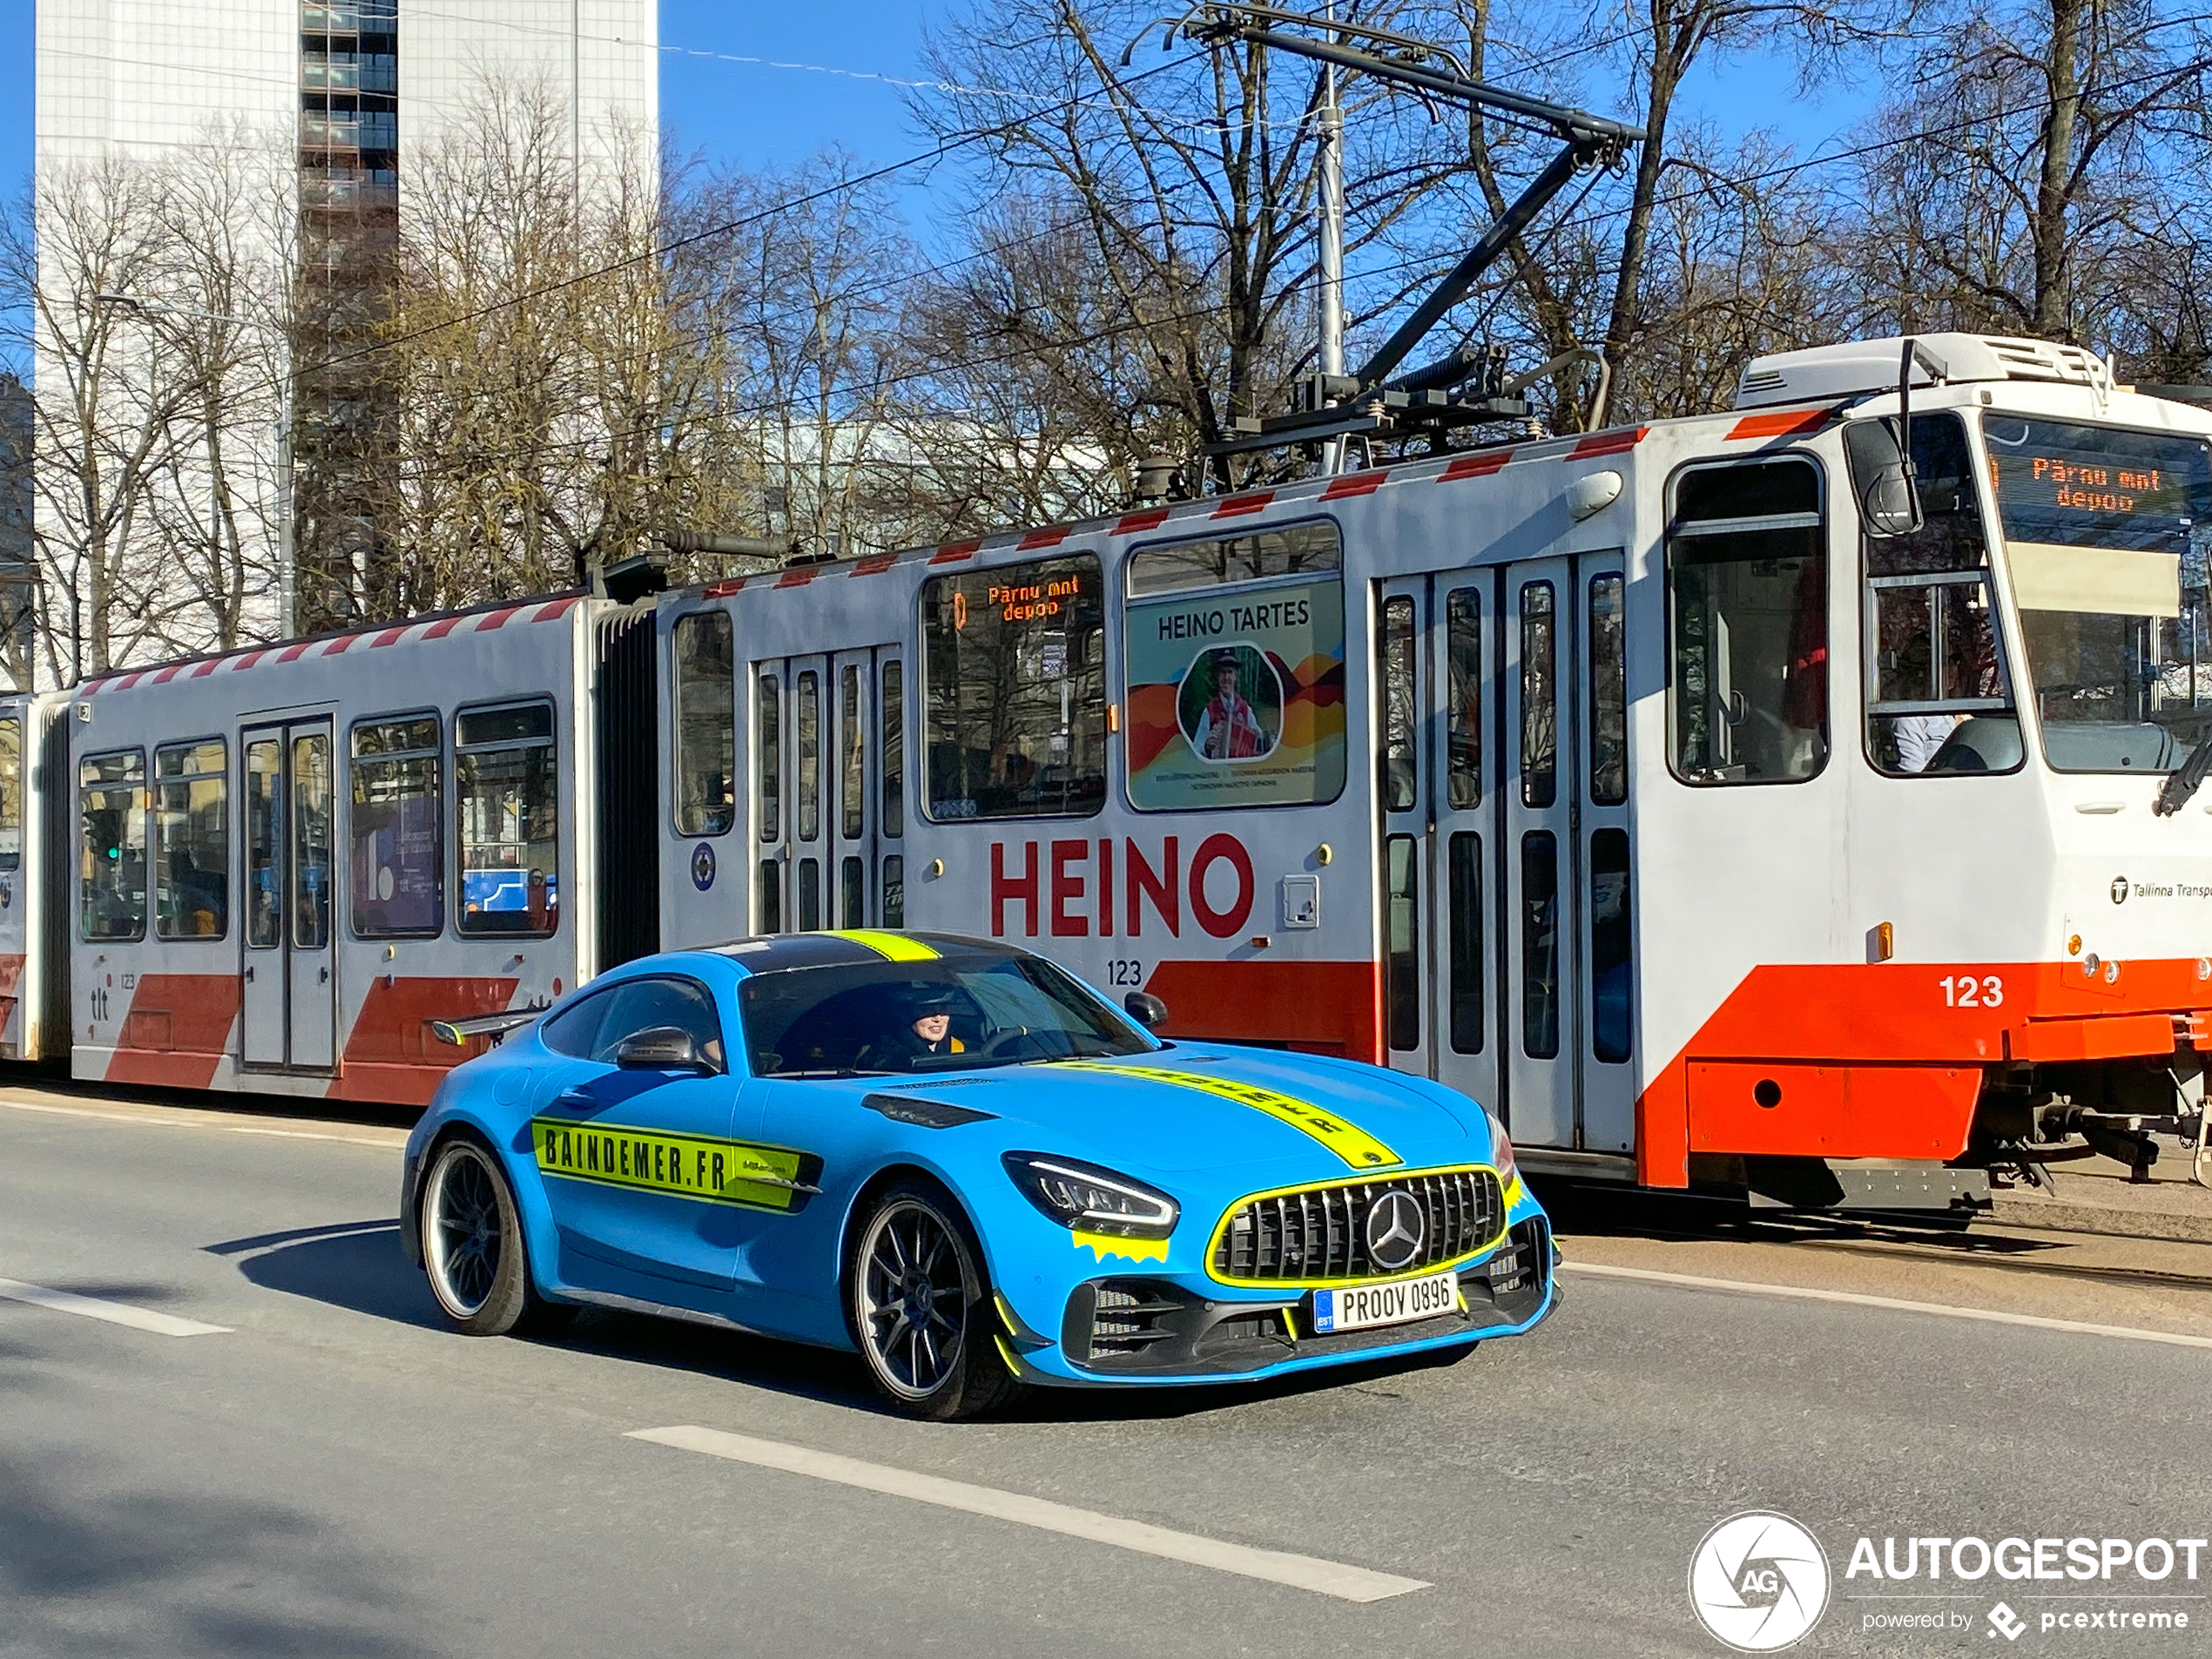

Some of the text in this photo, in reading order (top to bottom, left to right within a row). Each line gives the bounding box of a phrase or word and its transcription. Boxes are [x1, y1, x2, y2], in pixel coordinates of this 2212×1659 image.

[1158, 599, 1309, 641] HEINO TARTES
[990, 832, 1255, 939] HEINO
[2134, 881, 2173, 897] Tallinna
[121, 973, 135, 990] 123
[1108, 960, 1142, 986] 123
[1939, 974, 2004, 1008] 123
[544, 1130, 725, 1191] BAINDEMER.FR
[1343, 1277, 1450, 1323] PROOV 0896
[1317, 1316, 1333, 1326] EST
